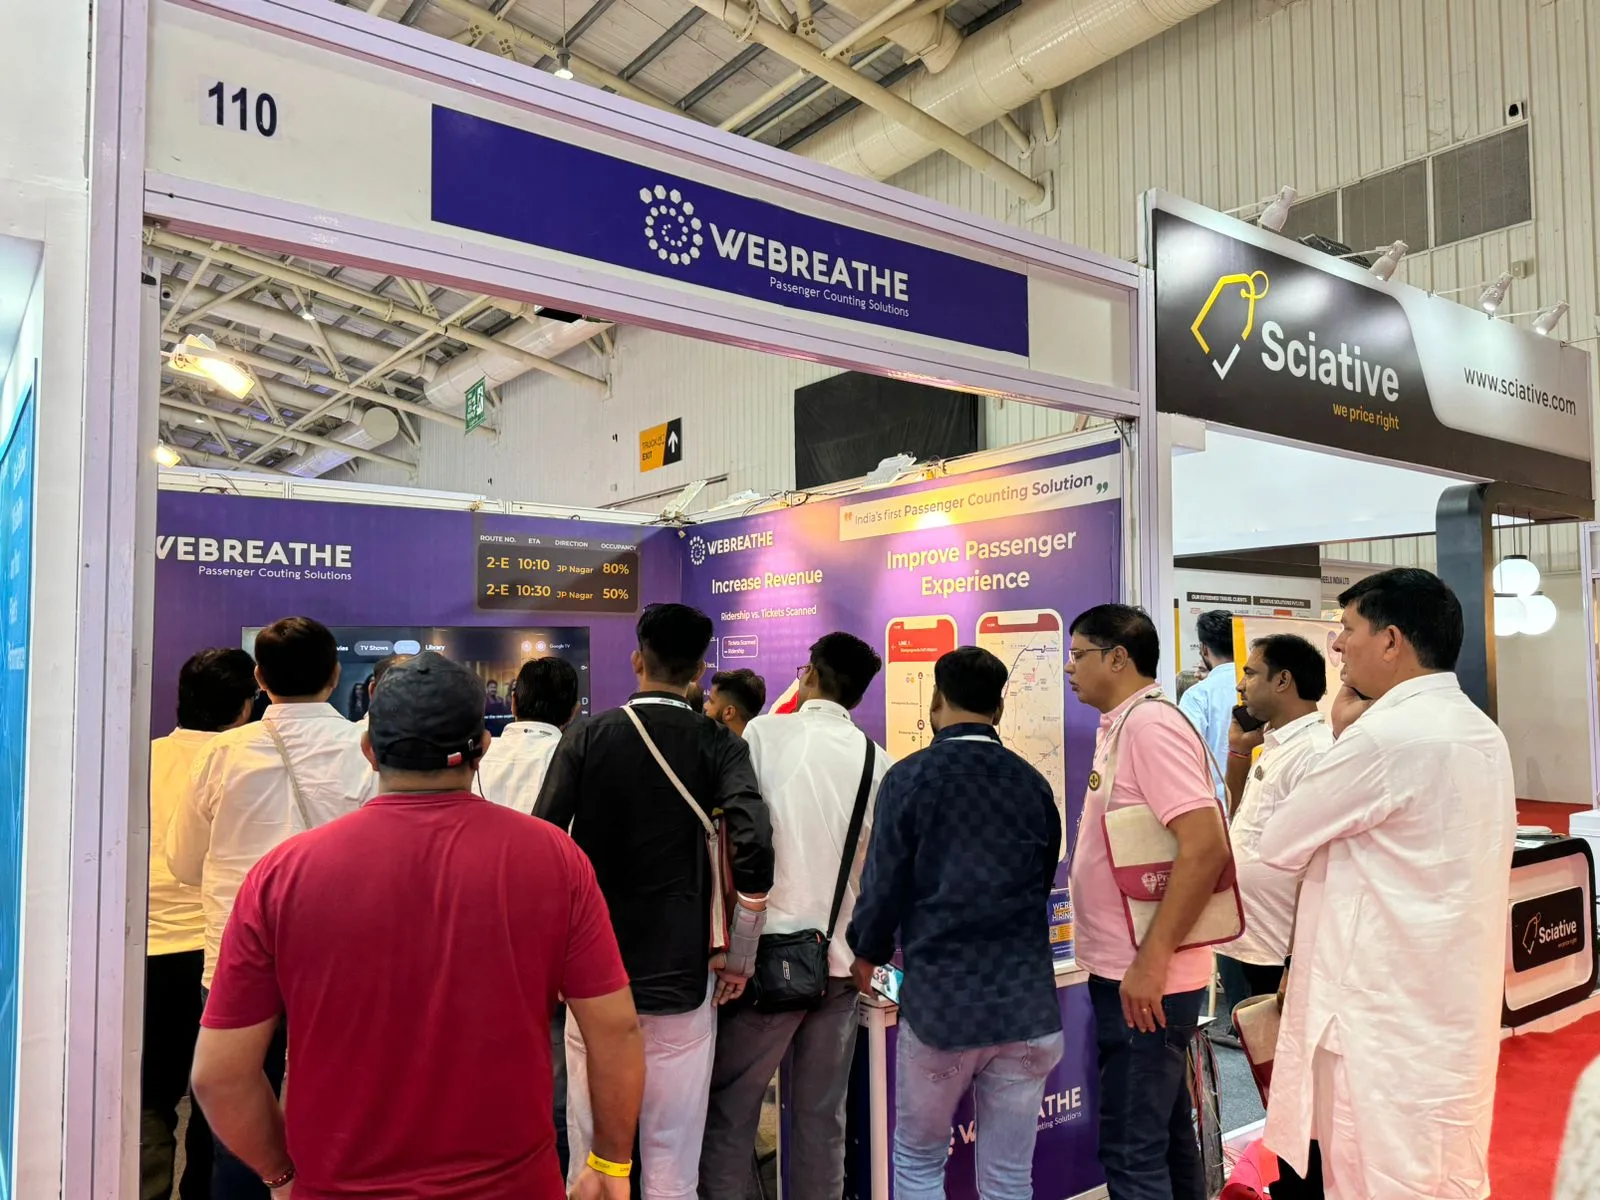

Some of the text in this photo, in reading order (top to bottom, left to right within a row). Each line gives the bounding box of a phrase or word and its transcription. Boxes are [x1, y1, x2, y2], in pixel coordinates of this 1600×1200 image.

[208, 81, 278, 137] 110
[709, 223, 909, 302] WEBREATHE
[770, 277, 910, 317] Passenger Counting Solutions
[1261, 320, 1400, 402] Sciative
[1463, 365, 1577, 416] www.sciative.com
[1333, 403, 1400, 432] we price right
[884, 508, 902, 520] first
[904, 499, 964, 519] Passenger
[968, 485, 1028, 507] Counting
[1032, 473, 1094, 496] Solution
[555, 540, 588, 548] DIRECTION
[601, 543, 637, 551] OCCUPANCY
[707, 531, 774, 555] WEBREATHE
[887, 532, 1077, 571] Improve Passenger
[198, 565, 352, 581] Passenger Couting Solutions
[486, 557, 630, 575] 2-E 10:10 JP Nagar 80%
[486, 584, 629, 601] 2-E 10:30 JP Nagar 50%
[712, 569, 823, 594] Increase Revenue
[921, 570, 1030, 598] Experience
[720, 605, 817, 622] Ridership vs. Tickets Scanned
[425, 644, 445, 652] Library
[1539, 920, 1577, 944] Sciative
[1055, 1111, 1082, 1125] Solutions
